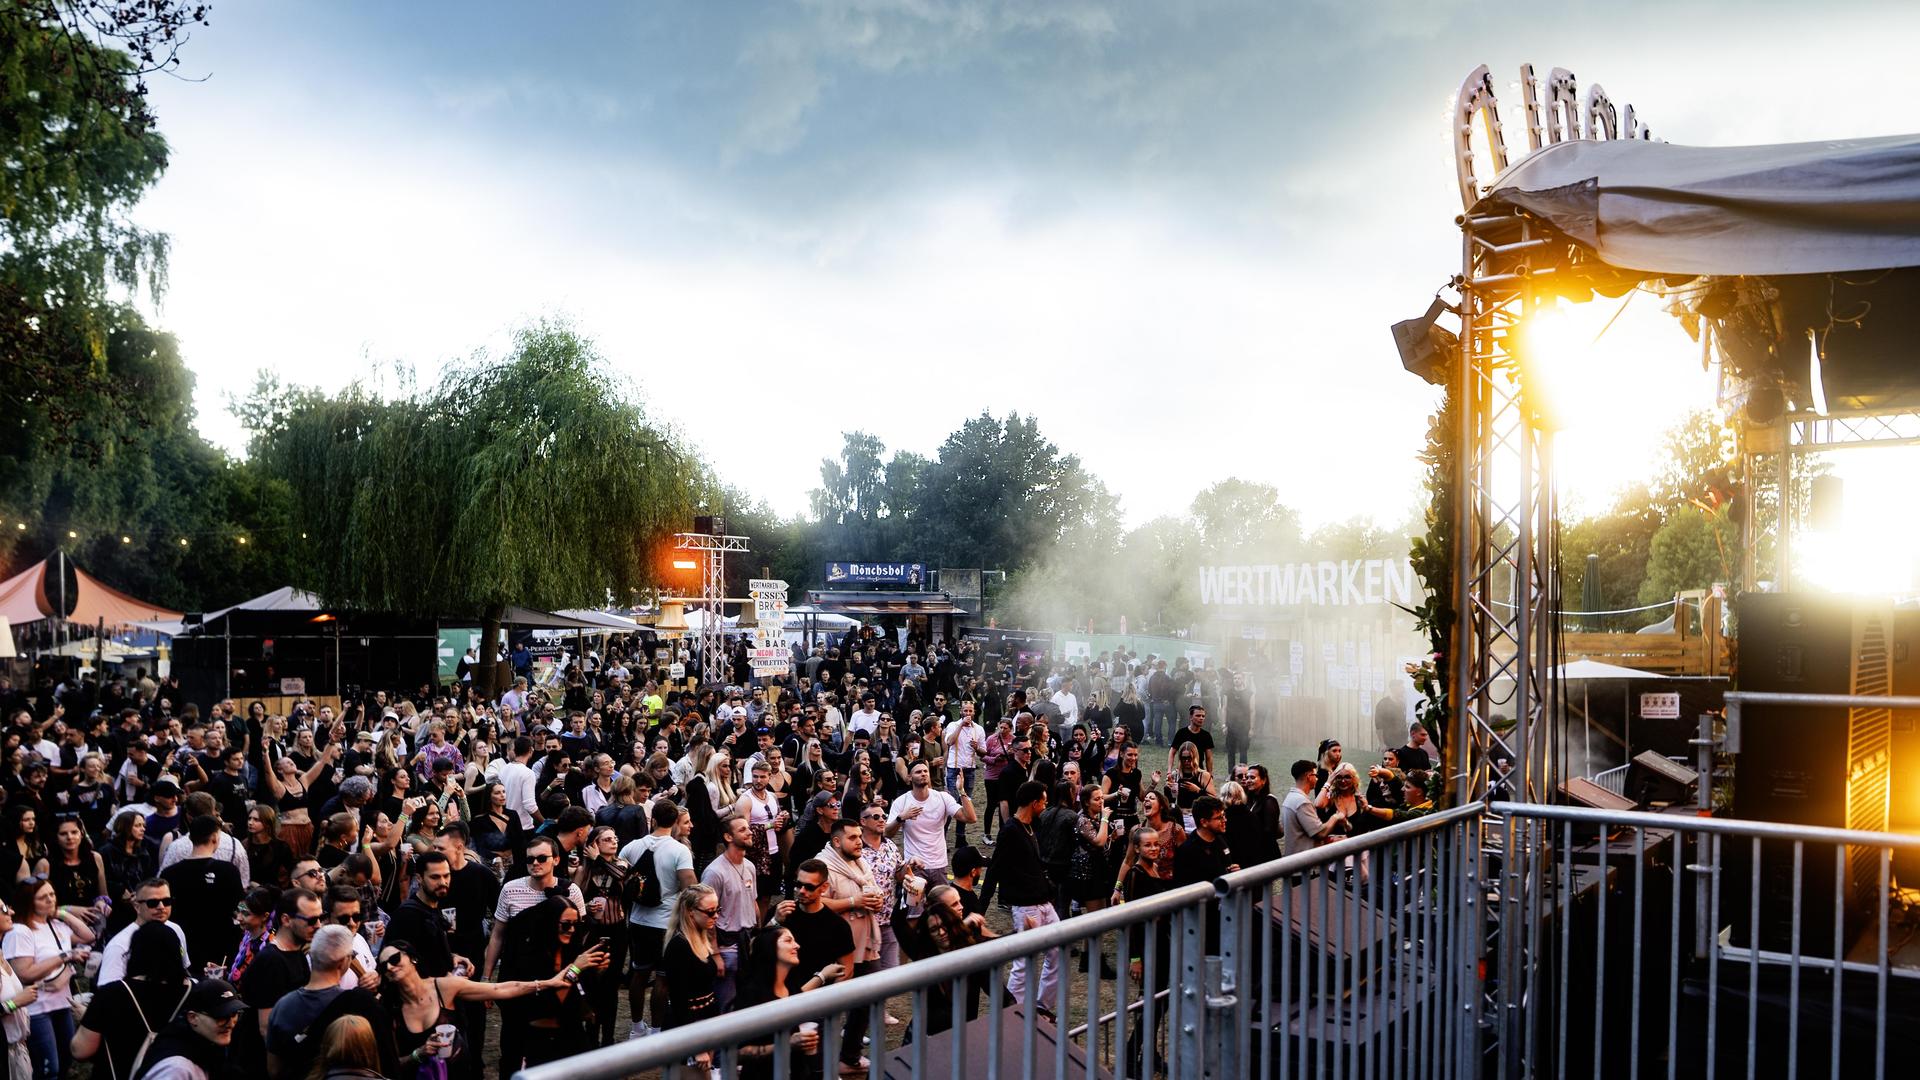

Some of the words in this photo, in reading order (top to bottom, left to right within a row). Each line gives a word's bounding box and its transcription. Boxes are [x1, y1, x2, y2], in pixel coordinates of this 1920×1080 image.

[850, 563, 905, 576] Mönchshof
[750, 581, 779, 589] WERTMARKEN
[1199, 558, 1413, 606] WERTMARKEN
[759, 591, 787, 600] ESSEN
[759, 601, 775, 611] BRK
[765, 629, 783, 638] VIP
[765, 639, 787, 648] BAR
[775, 649, 789, 657] BAR
[757, 659, 788, 667] TOILETTEN
